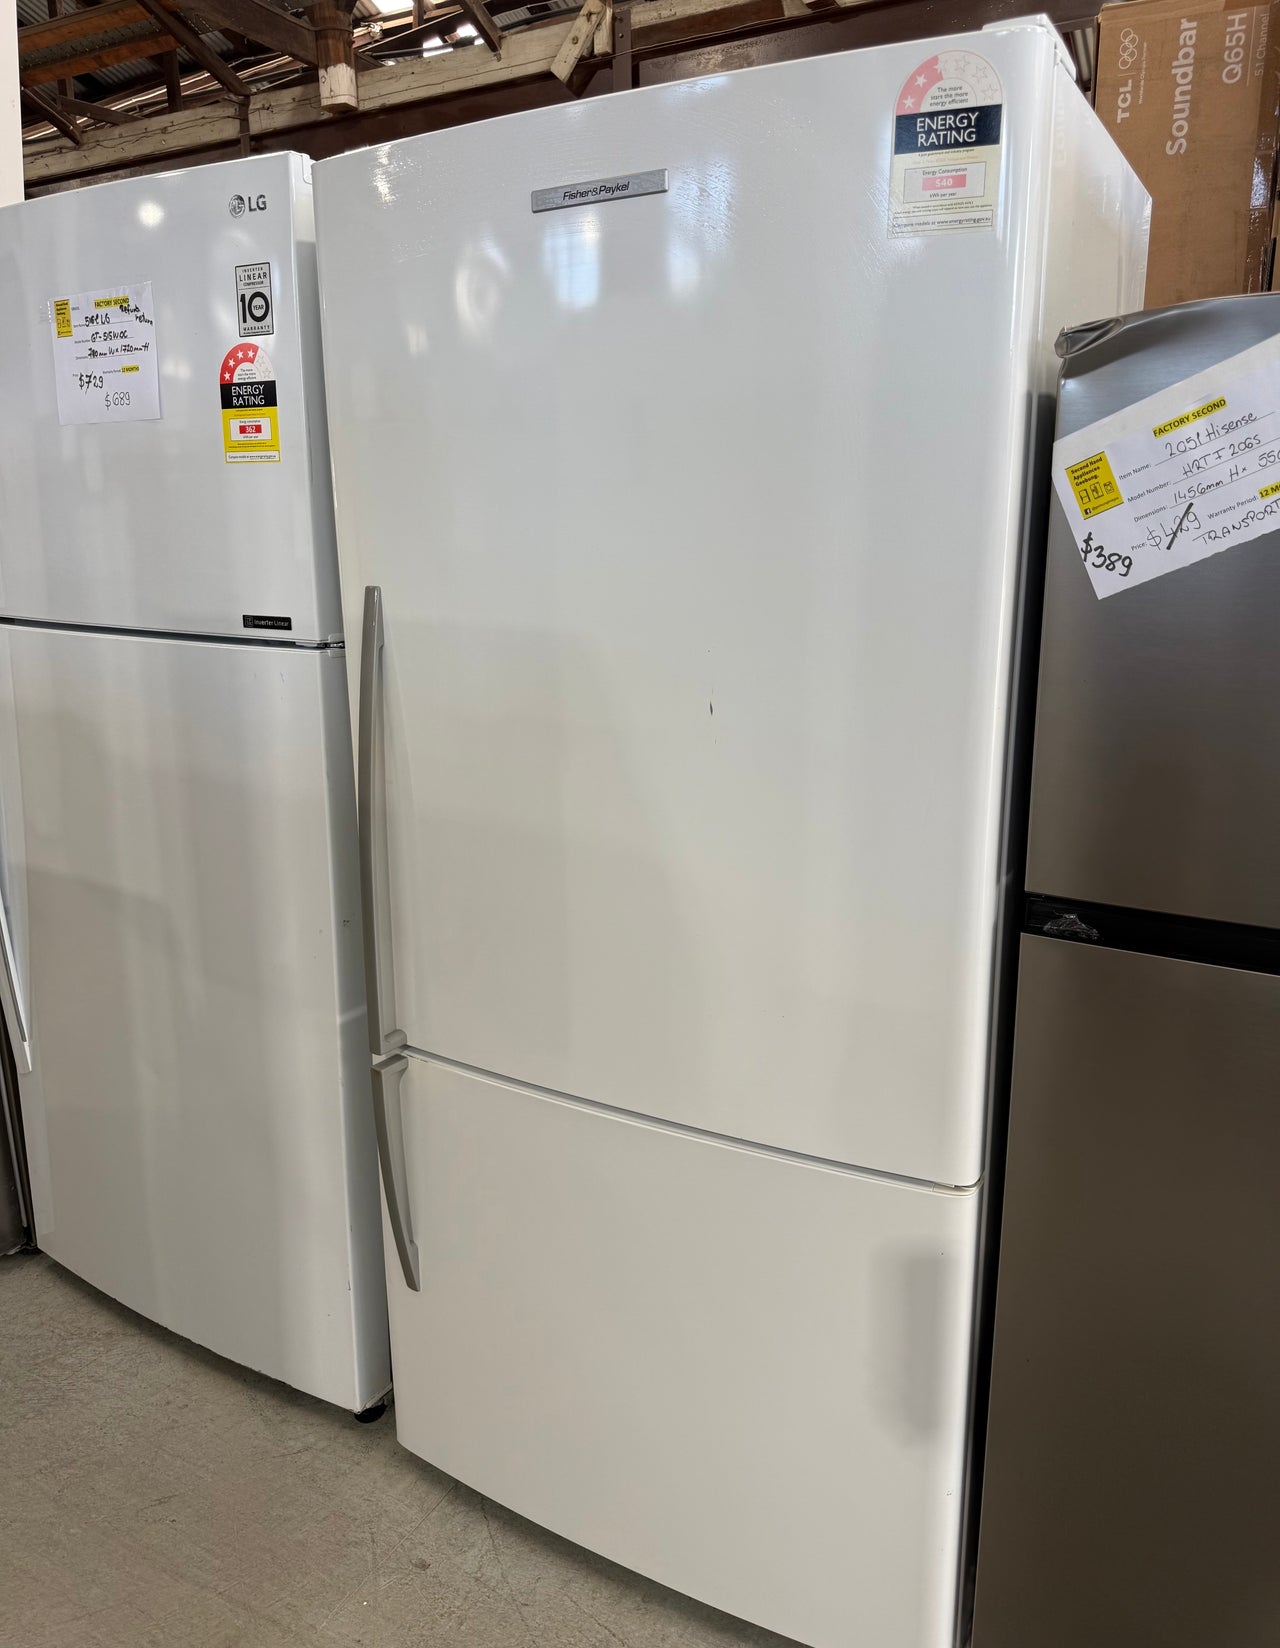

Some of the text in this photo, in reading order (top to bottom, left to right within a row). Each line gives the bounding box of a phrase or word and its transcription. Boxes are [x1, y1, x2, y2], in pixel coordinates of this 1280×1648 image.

[1255, 13, 1270, 59] Channel
[1222, 12, 1248, 84] Q65H
[1165, 18, 1198, 155] Soundbar
[929, 100, 948, 108] energy
[1116, 79, 1133, 124] TCL
[916, 112, 979, 132] ENERGY
[918, 128, 976, 148] RATING
[922, 167, 968, 177] Energy Consumption
[935, 178, 953, 188] 540
[248, 194, 267, 212] LG
[239, 272, 267, 281] LINEAR
[94, 298, 130, 308] FACTORY SECOND
[240, 291, 270, 323] 10
[231, 384, 265, 396] ENERGY
[105, 391, 131, 411] $689
[232, 395, 265, 407] RATING
[1152, 398, 1227, 438] FACTORY SECOND
[245, 425, 256, 433] 362
[1119, 468, 1133, 481] Item
[1133, 464, 1152, 477] Name:
[1205, 412, 1257, 441] Hisense
[1071, 456, 1103, 475] Second Hand
[1073, 466, 1100, 481] Appliances
[1127, 490, 1146, 503] Model
[1146, 480, 1172, 496] Number:
[1134, 505, 1169, 523] Dimensions:
[1174, 479, 1224, 504] 1456mm
[1207, 505, 1236, 520] Warranty
[1236, 495, 1259, 510] Period:
[1259, 488, 1270, 499] 12
[1081, 531, 1133, 577] $389
[1131, 541, 1148, 552] Price:
